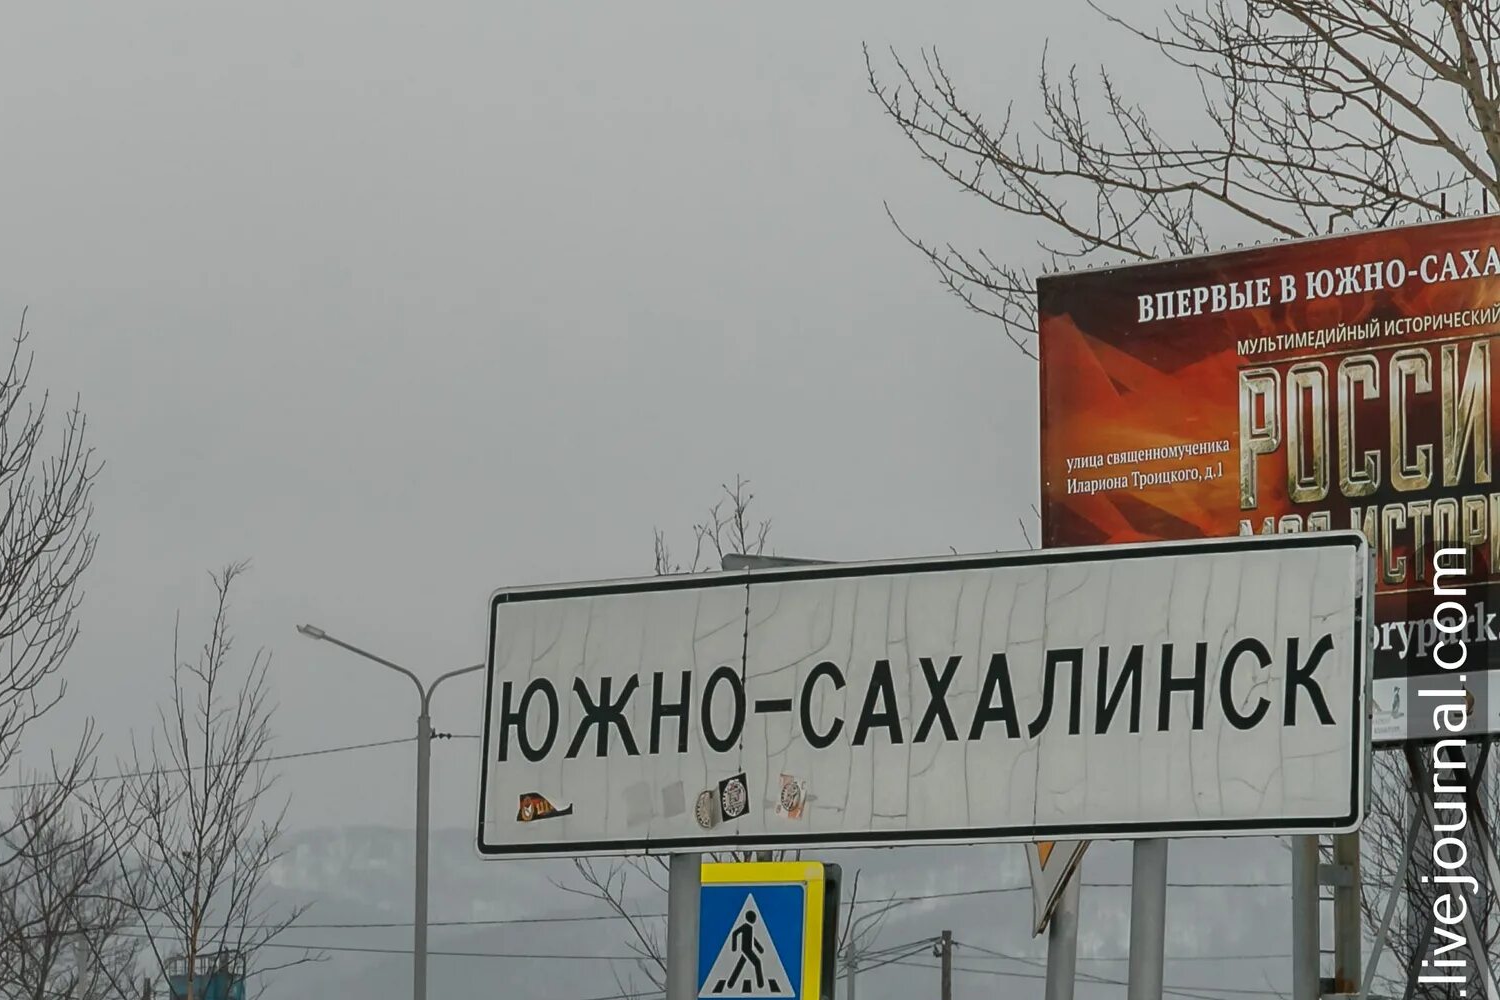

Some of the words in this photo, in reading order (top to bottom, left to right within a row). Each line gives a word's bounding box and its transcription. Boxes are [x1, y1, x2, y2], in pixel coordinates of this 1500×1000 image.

[1138, 277, 1272, 323] ВПЕРВЫЕ
[1279, 273, 1297, 303] В
[1305, 246, 1500, 300] ЮЖНО-САХА
[1237, 318, 1381, 356] МУЛЬТИМЕДИЙНЫЙ
[1384, 302, 1500, 336] ИСТОРИЧЕСКИЙ
[1066, 454, 1104, 474] улица
[1106, 439, 1230, 466] священномученика
[1238, 339, 1492, 510] РОССИ
[1066, 475, 1128, 496] Илариона
[1131, 466, 1202, 490] Троицкого,
[1204, 461, 1223, 481] д.1
[497, 633, 1337, 764] ЮЖНО-САХАЛИНСК
